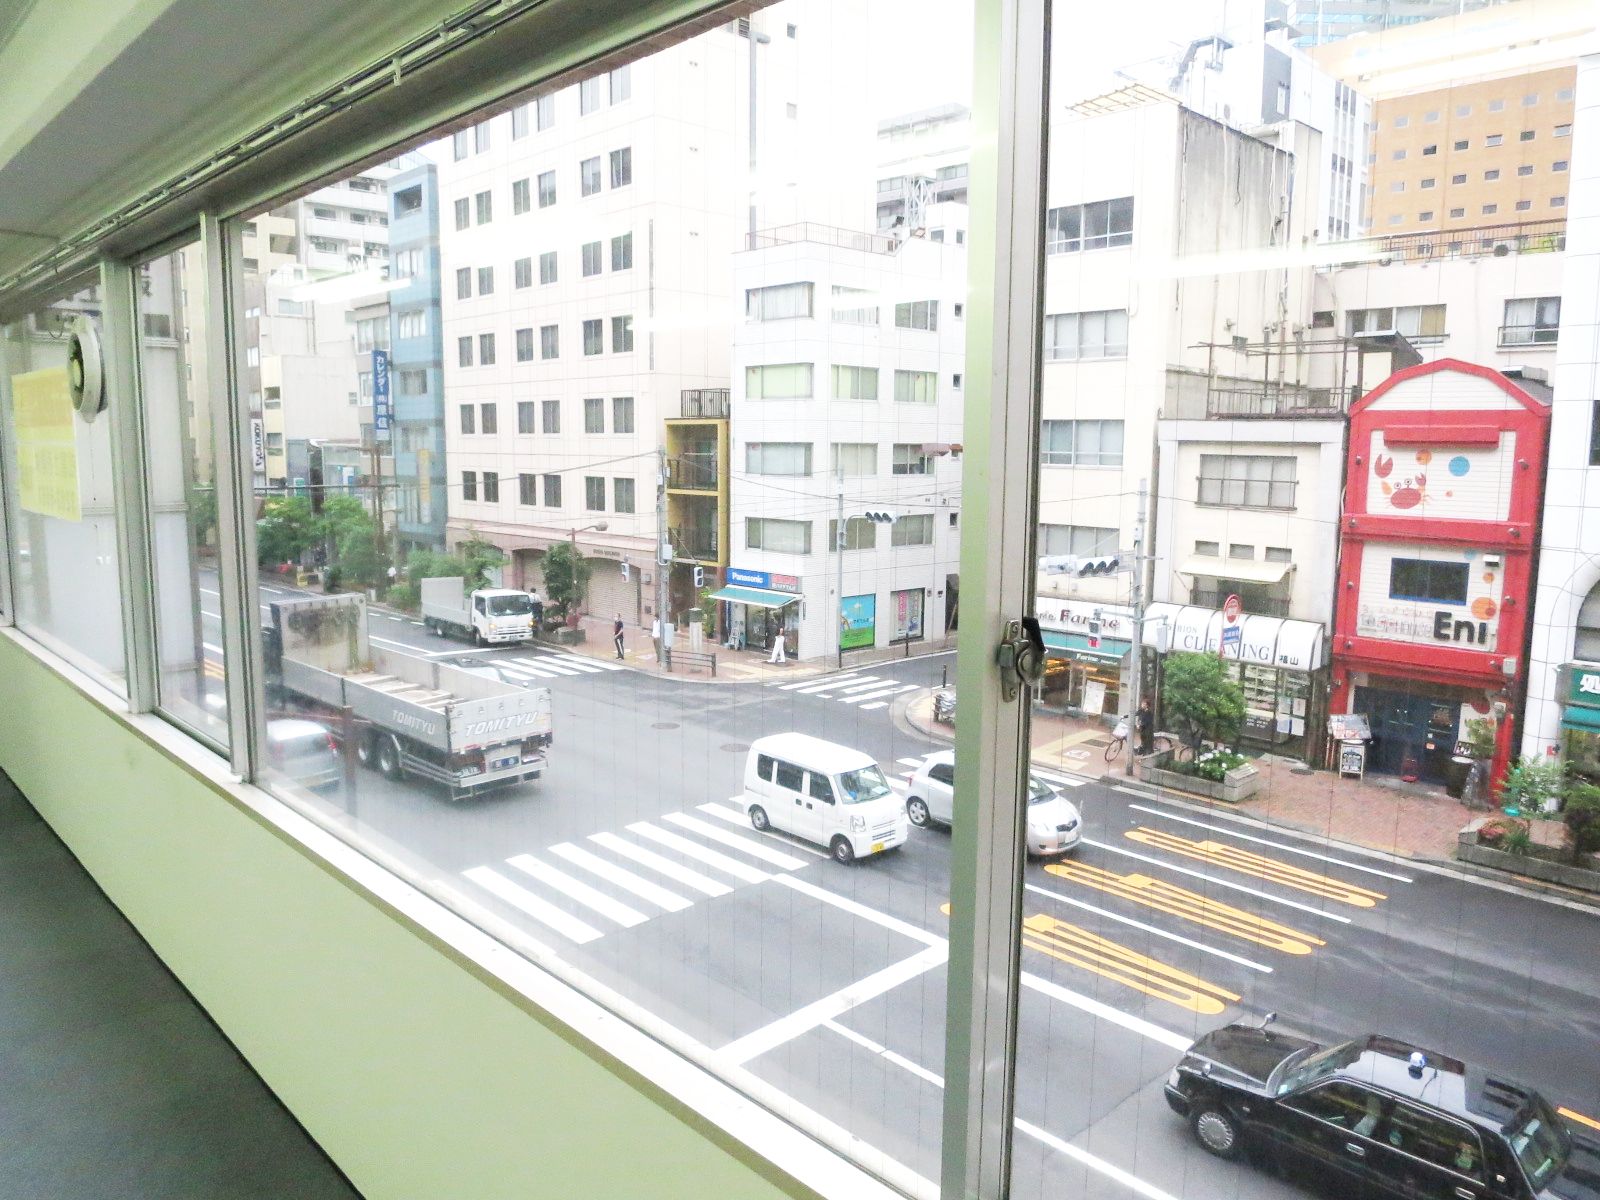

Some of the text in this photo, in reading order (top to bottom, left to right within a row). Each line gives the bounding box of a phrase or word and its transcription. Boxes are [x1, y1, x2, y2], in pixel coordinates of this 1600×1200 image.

[731, 571, 764, 584] Panasonic
[1059, 608, 1119, 629] Farne
[1434, 611, 1488, 644] Eni
[1279, 654, 1299, 666] 福山
[392, 709, 435, 735] TOMITYU
[465, 711, 538, 736] TOMITYU
